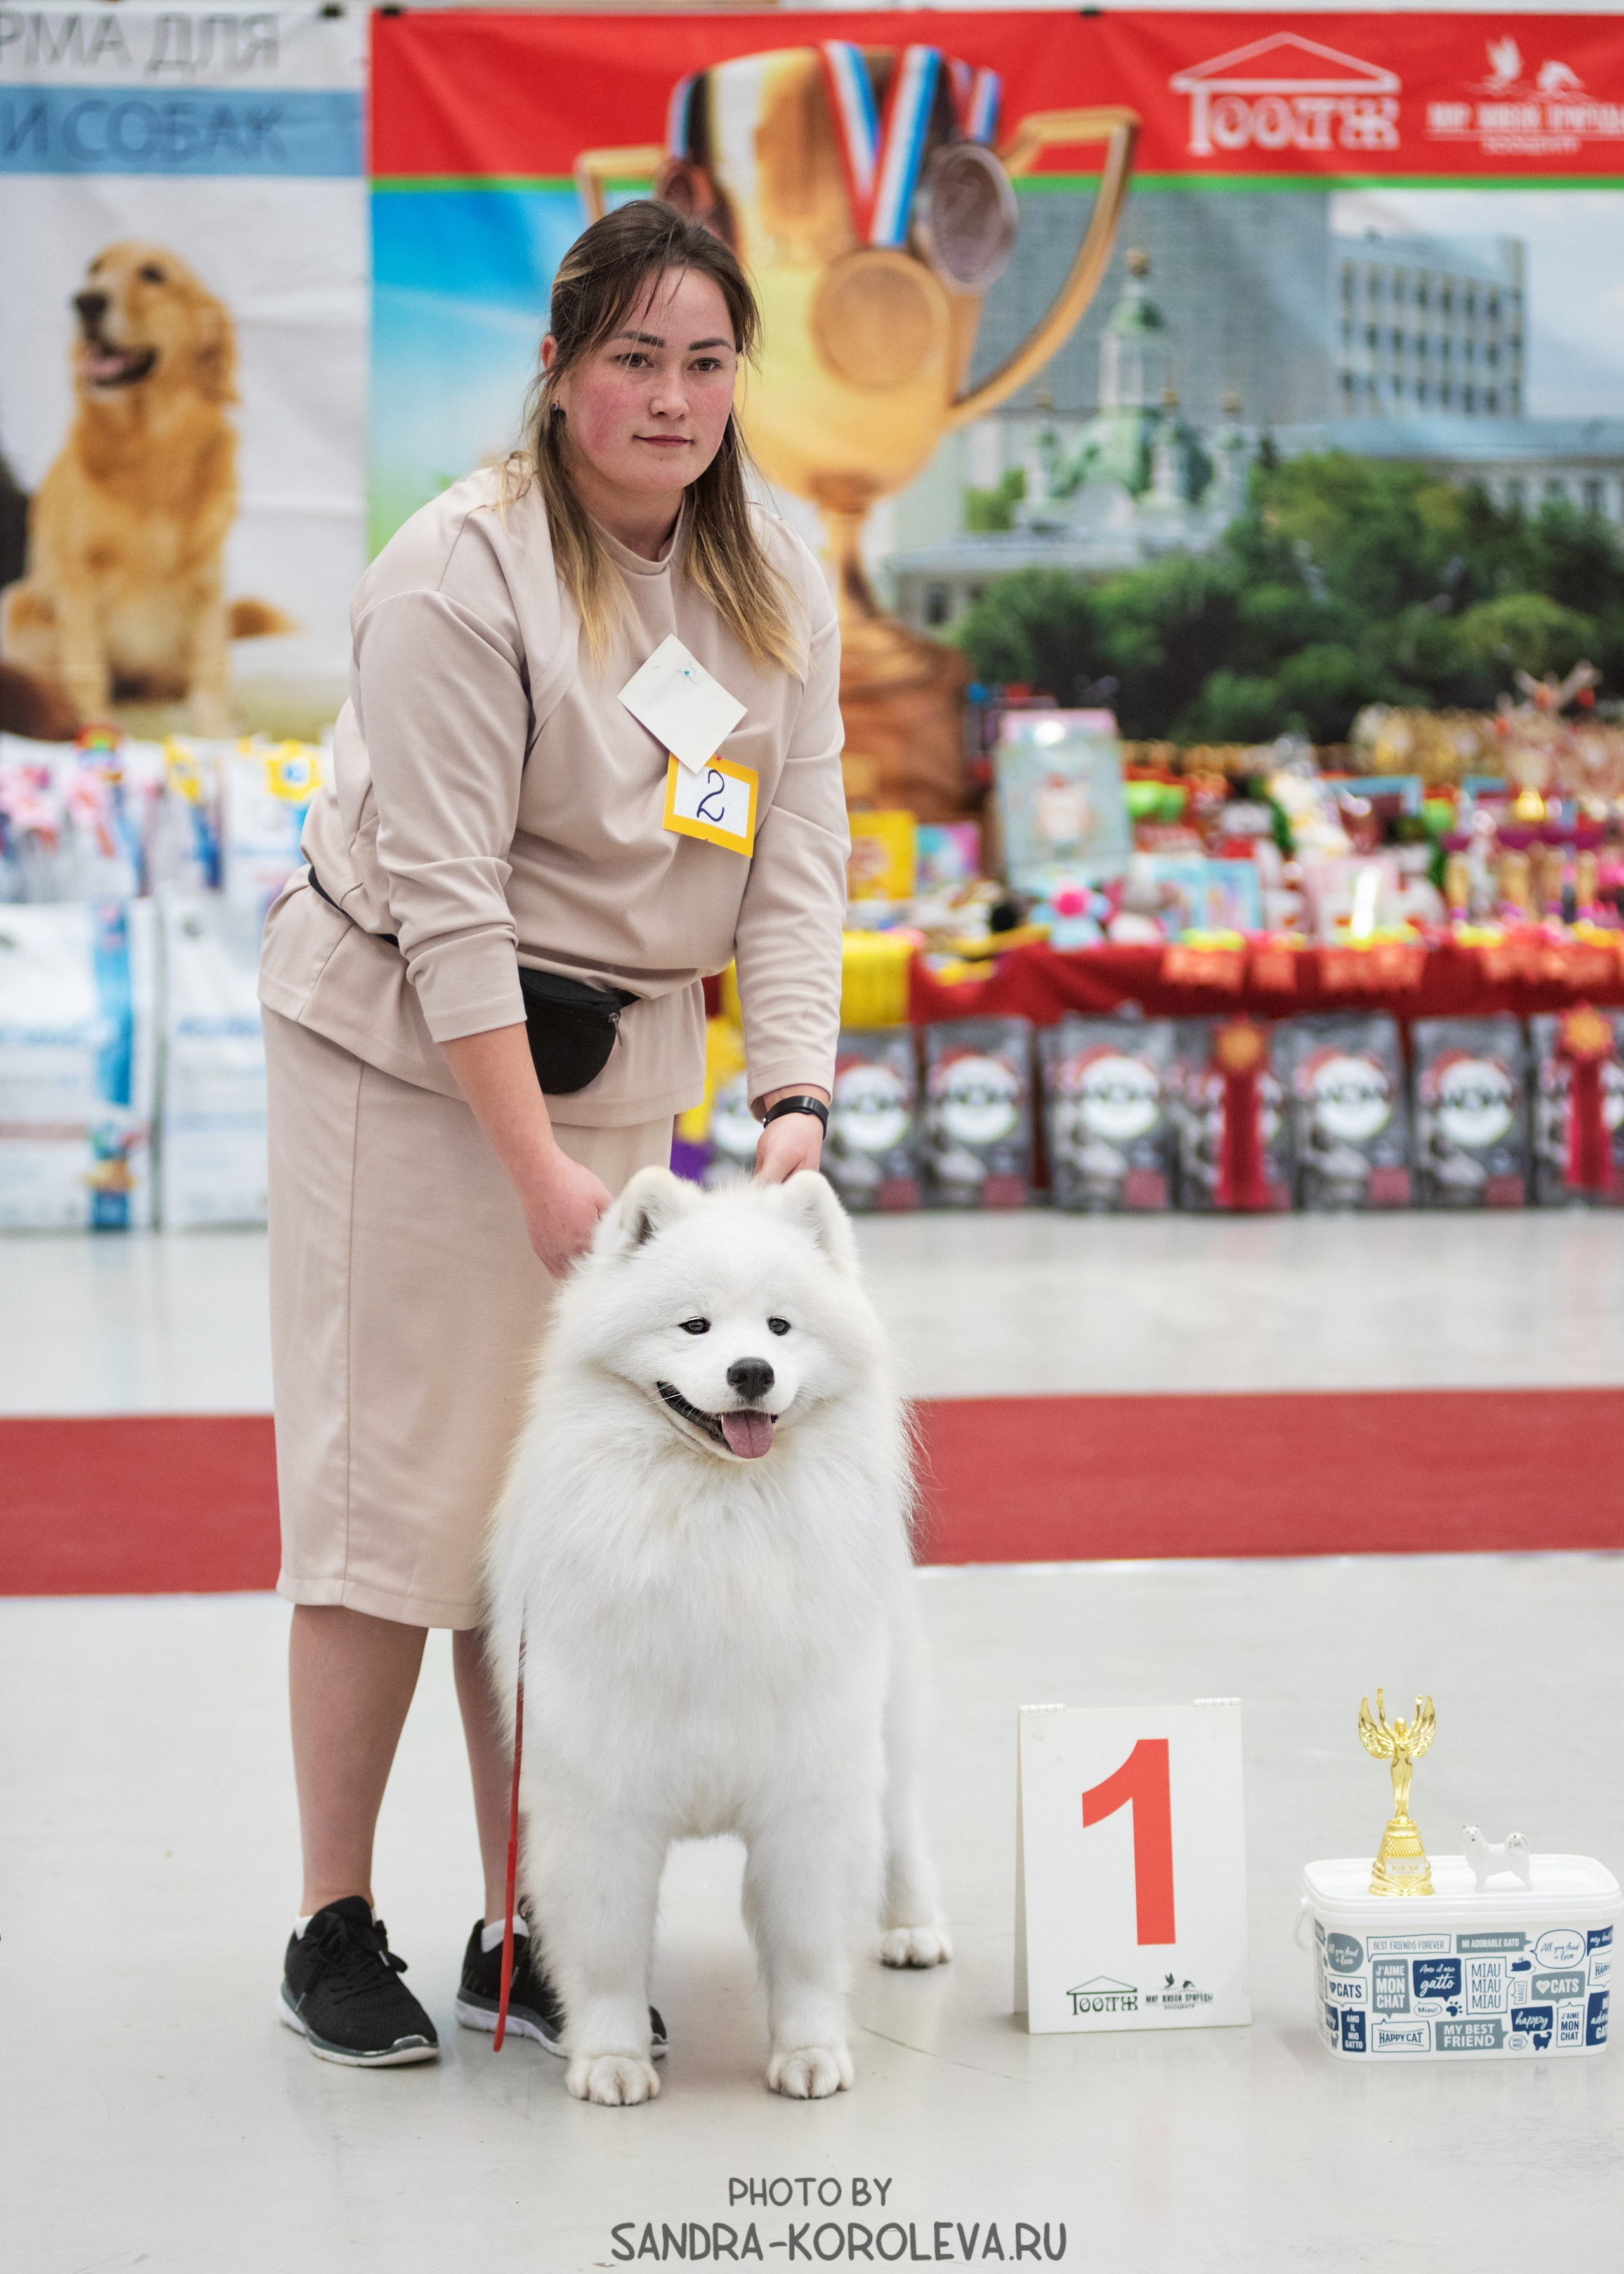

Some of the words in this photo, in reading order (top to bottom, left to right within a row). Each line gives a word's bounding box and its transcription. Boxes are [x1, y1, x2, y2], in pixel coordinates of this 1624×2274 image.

[145, 12, 280, 79] ДЛЯ
[65, 100, 287, 163] СОБАК
[696, 769, 725, 822] 2
[1082, 1738, 1176, 1945] 1
[1373, 1942, 1387, 1950] BEST
[1390, 1941, 1417, 1950] FRIENDS
[1418, 1940, 1444, 1949] FOREVER
[1462, 1940, 1470, 1949] MI
[1472, 1938, 1502, 1948] ADORABLE
[1503, 1938, 1519, 1947] GATO
[1541, 1942, 1553, 1953] All
[1561, 1950, 1575, 1961] love
[1375, 1966, 1405, 1976] J'AIME
[1472, 1963, 1500, 1978] MIAU
[1337, 1983, 1362, 1998] CATS
[1375, 1978, 1406, 1994] MON
[1419, 1973, 1455, 1997] gatto
[1472, 1978, 1501, 1993] MIAU
[1550, 1978, 1579, 1993] CATS
[1146, 1995, 1159, 2004] МИР
[1162, 1993, 1182, 2003] ЖИВОЙ
[1185, 1992, 1214, 2002] ПРИРОДЫ
[1376, 1994, 1406, 2009] CHAT
[1472, 1994, 1501, 2009] MIAU
[1346, 2014, 1359, 2023] AMO
[1515, 2010, 1549, 2030] happy
[1444, 2025, 1462, 2035] MY
[1465, 2024, 1495, 2034] BEST
[1561, 2021, 1580, 2032] MON
[1347, 2032, 1359, 2040] MIO
[1379, 2032, 1405, 2044] HAPPY
[1406, 2032, 1423, 2043] CAT
[1444, 2035, 1495, 2047] FRIEND
[1561, 2032, 1579, 2041] CHAT
[1345, 2040, 1363, 2049] GATTO
